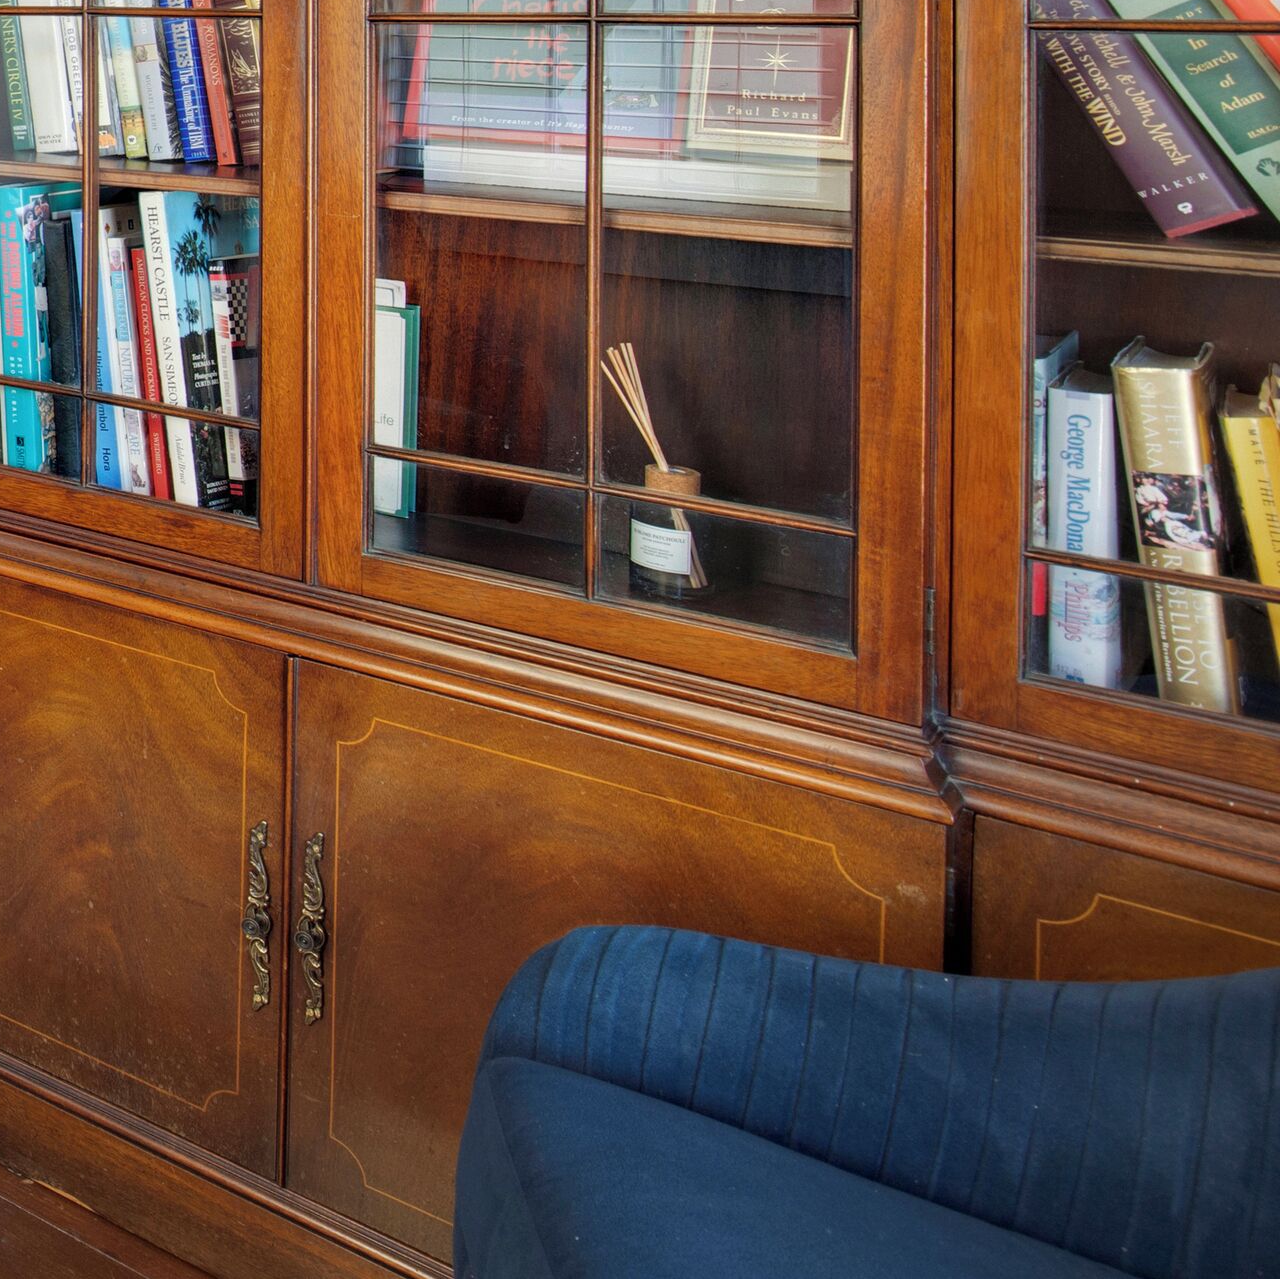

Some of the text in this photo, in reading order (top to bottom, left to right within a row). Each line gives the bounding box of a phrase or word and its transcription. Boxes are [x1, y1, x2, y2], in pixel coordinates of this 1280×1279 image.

[66, 27, 77, 54] BOB
[170, 22, 192, 68] BLUES
[202, 24, 222, 86] ROMANOVS
[524, 26, 571, 54] the
[1186, 36, 1207, 51] In
[69, 55, 83, 102] GREENE
[179, 68, 192, 85] The
[490, 49, 577, 82] niece
[1081, 55, 1113, 95] STORY
[1185, 48, 1239, 77] Search
[5, 55, 23, 108] CIRCLE
[740, 87, 807, 103] Richard
[1045, 39, 1128, 148] WITH THE WIND
[1219, 73, 1236, 91] of
[13, 109, 23, 121] IV
[726, 104, 819, 121] Paul Evans
[1218, 88, 1266, 114] Adam
[451, 114, 545, 127] From the creator of
[1125, 86, 1157, 128] John
[1142, 121, 1188, 168] Marsh
[188, 130, 201, 150] IBM
[1136, 170, 1210, 200] WALKER
[146, 206, 165, 264] HEARST
[153, 265, 171, 321] CASTLE
[10, 290, 26, 338] ALBUM
[135, 256, 162, 475] AMERICAN CLOCKS AND SWEDBERG
[161, 335, 175, 362] SAN
[120, 346, 135, 397] NATURAL
[1139, 380, 1164, 471] SHAARA
[1160, 402, 1184, 450] JEFF
[101, 446, 112, 472] Hora
[1060, 412, 1092, 555] George MacDona
[1257, 478, 1277, 508] THE
[1053, 580, 1089, 644] Phillips
[1161, 553, 1200, 687] RBELLION
[1156, 604, 1174, 684] American Revolution
[1197, 638, 1220, 671] TO
